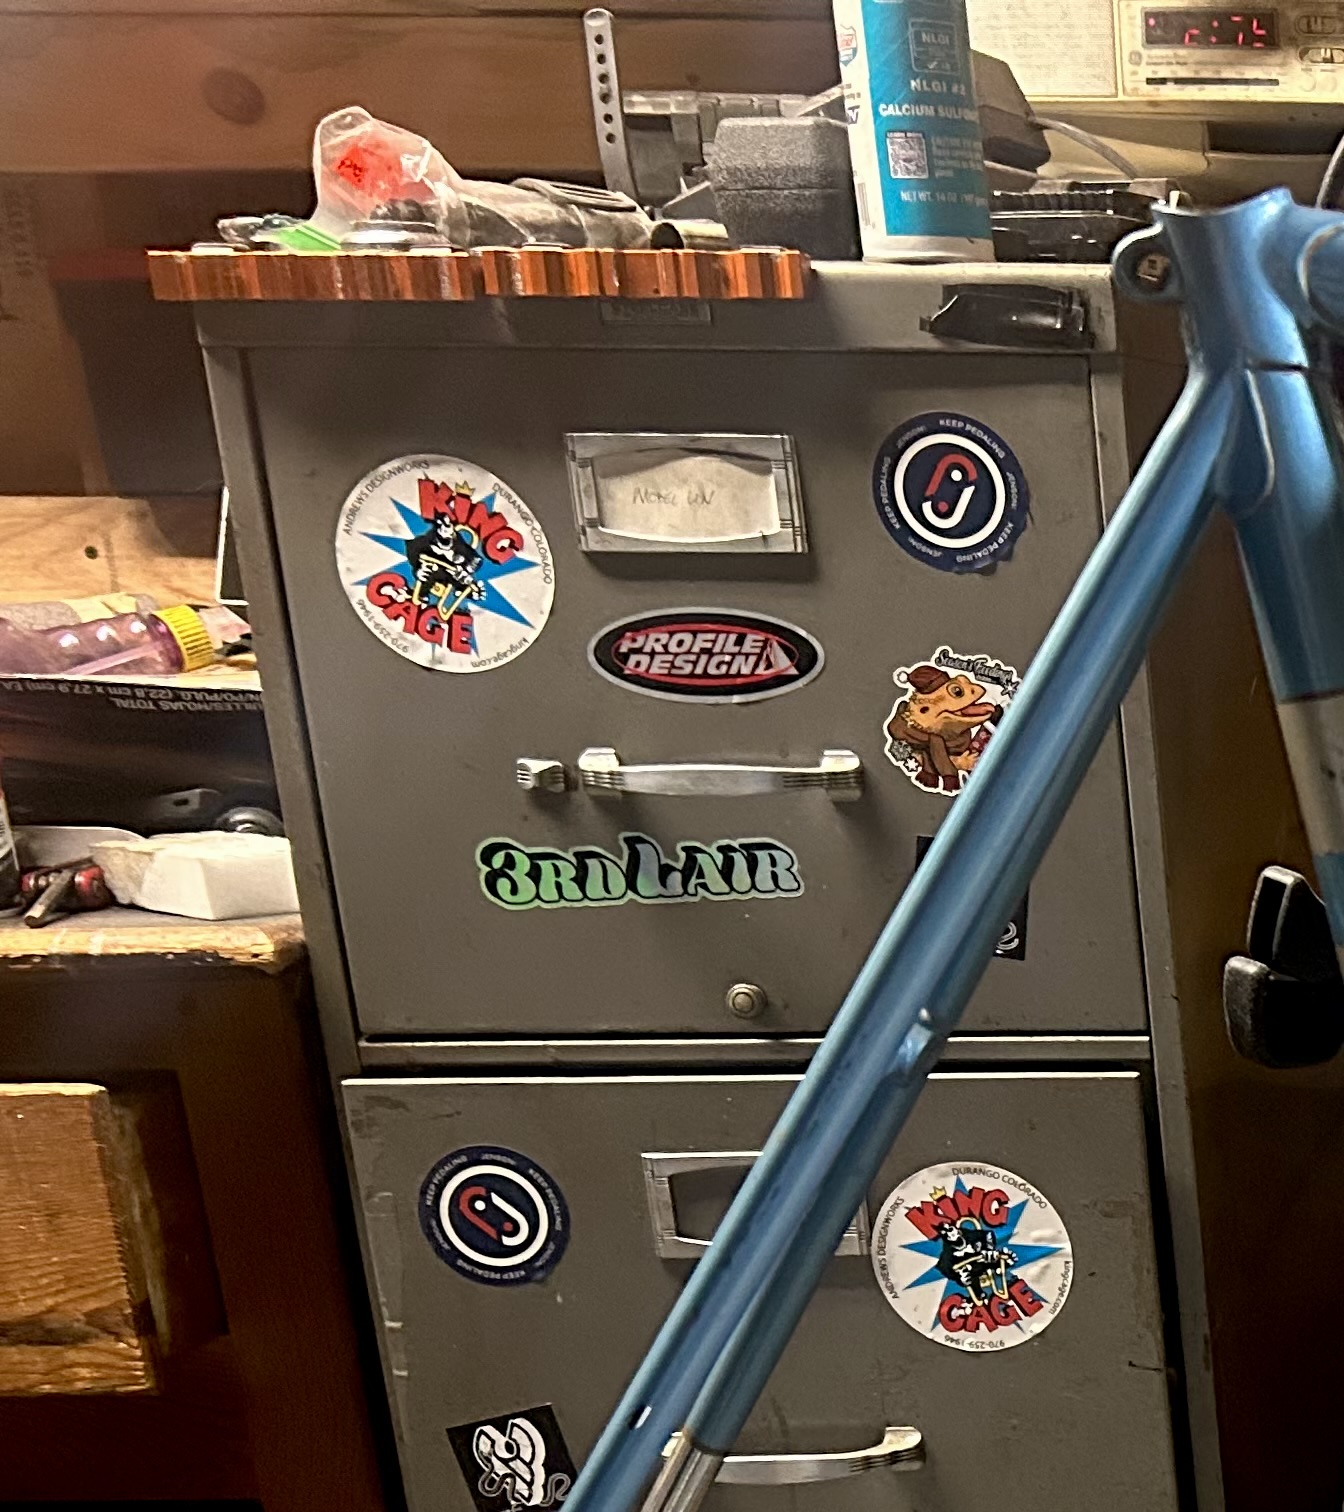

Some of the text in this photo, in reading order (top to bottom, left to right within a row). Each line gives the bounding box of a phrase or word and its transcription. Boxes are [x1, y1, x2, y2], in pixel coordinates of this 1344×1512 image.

[911, 80, 947, 92] NLGI
[879, 104, 935, 117] CALCIUM
[939, 418, 1006, 460] KEEP PEDALING
[343, 459, 430, 535] ANDREWS DESIGNWORKS
[884, 505, 901, 530] KEEP
[418, 478, 524, 564] KING
[491, 482, 553, 585] DURANGO COLORADO
[956, 521, 1014, 563] KEEP PEDALING
[365, 571, 475, 654] CAGE
[471, 637, 529, 668] kingcage.com
[619, 632, 764, 653] PROFILE
[623, 654, 768, 675] DESIGN
[110, 697, 158, 709] TOTAL
[952, 1167, 1047, 1210] DURANGO COLORADO
[904, 1186, 1010, 1240] KING
[878, 1197, 905, 1300] ANDREWS DESIGNWORKS
[938, 1278, 1044, 1334] CAGE
[1048, 1260, 1072, 1315] kingcage.com
[944, 1334, 1006, 1350] 970-259-1946
